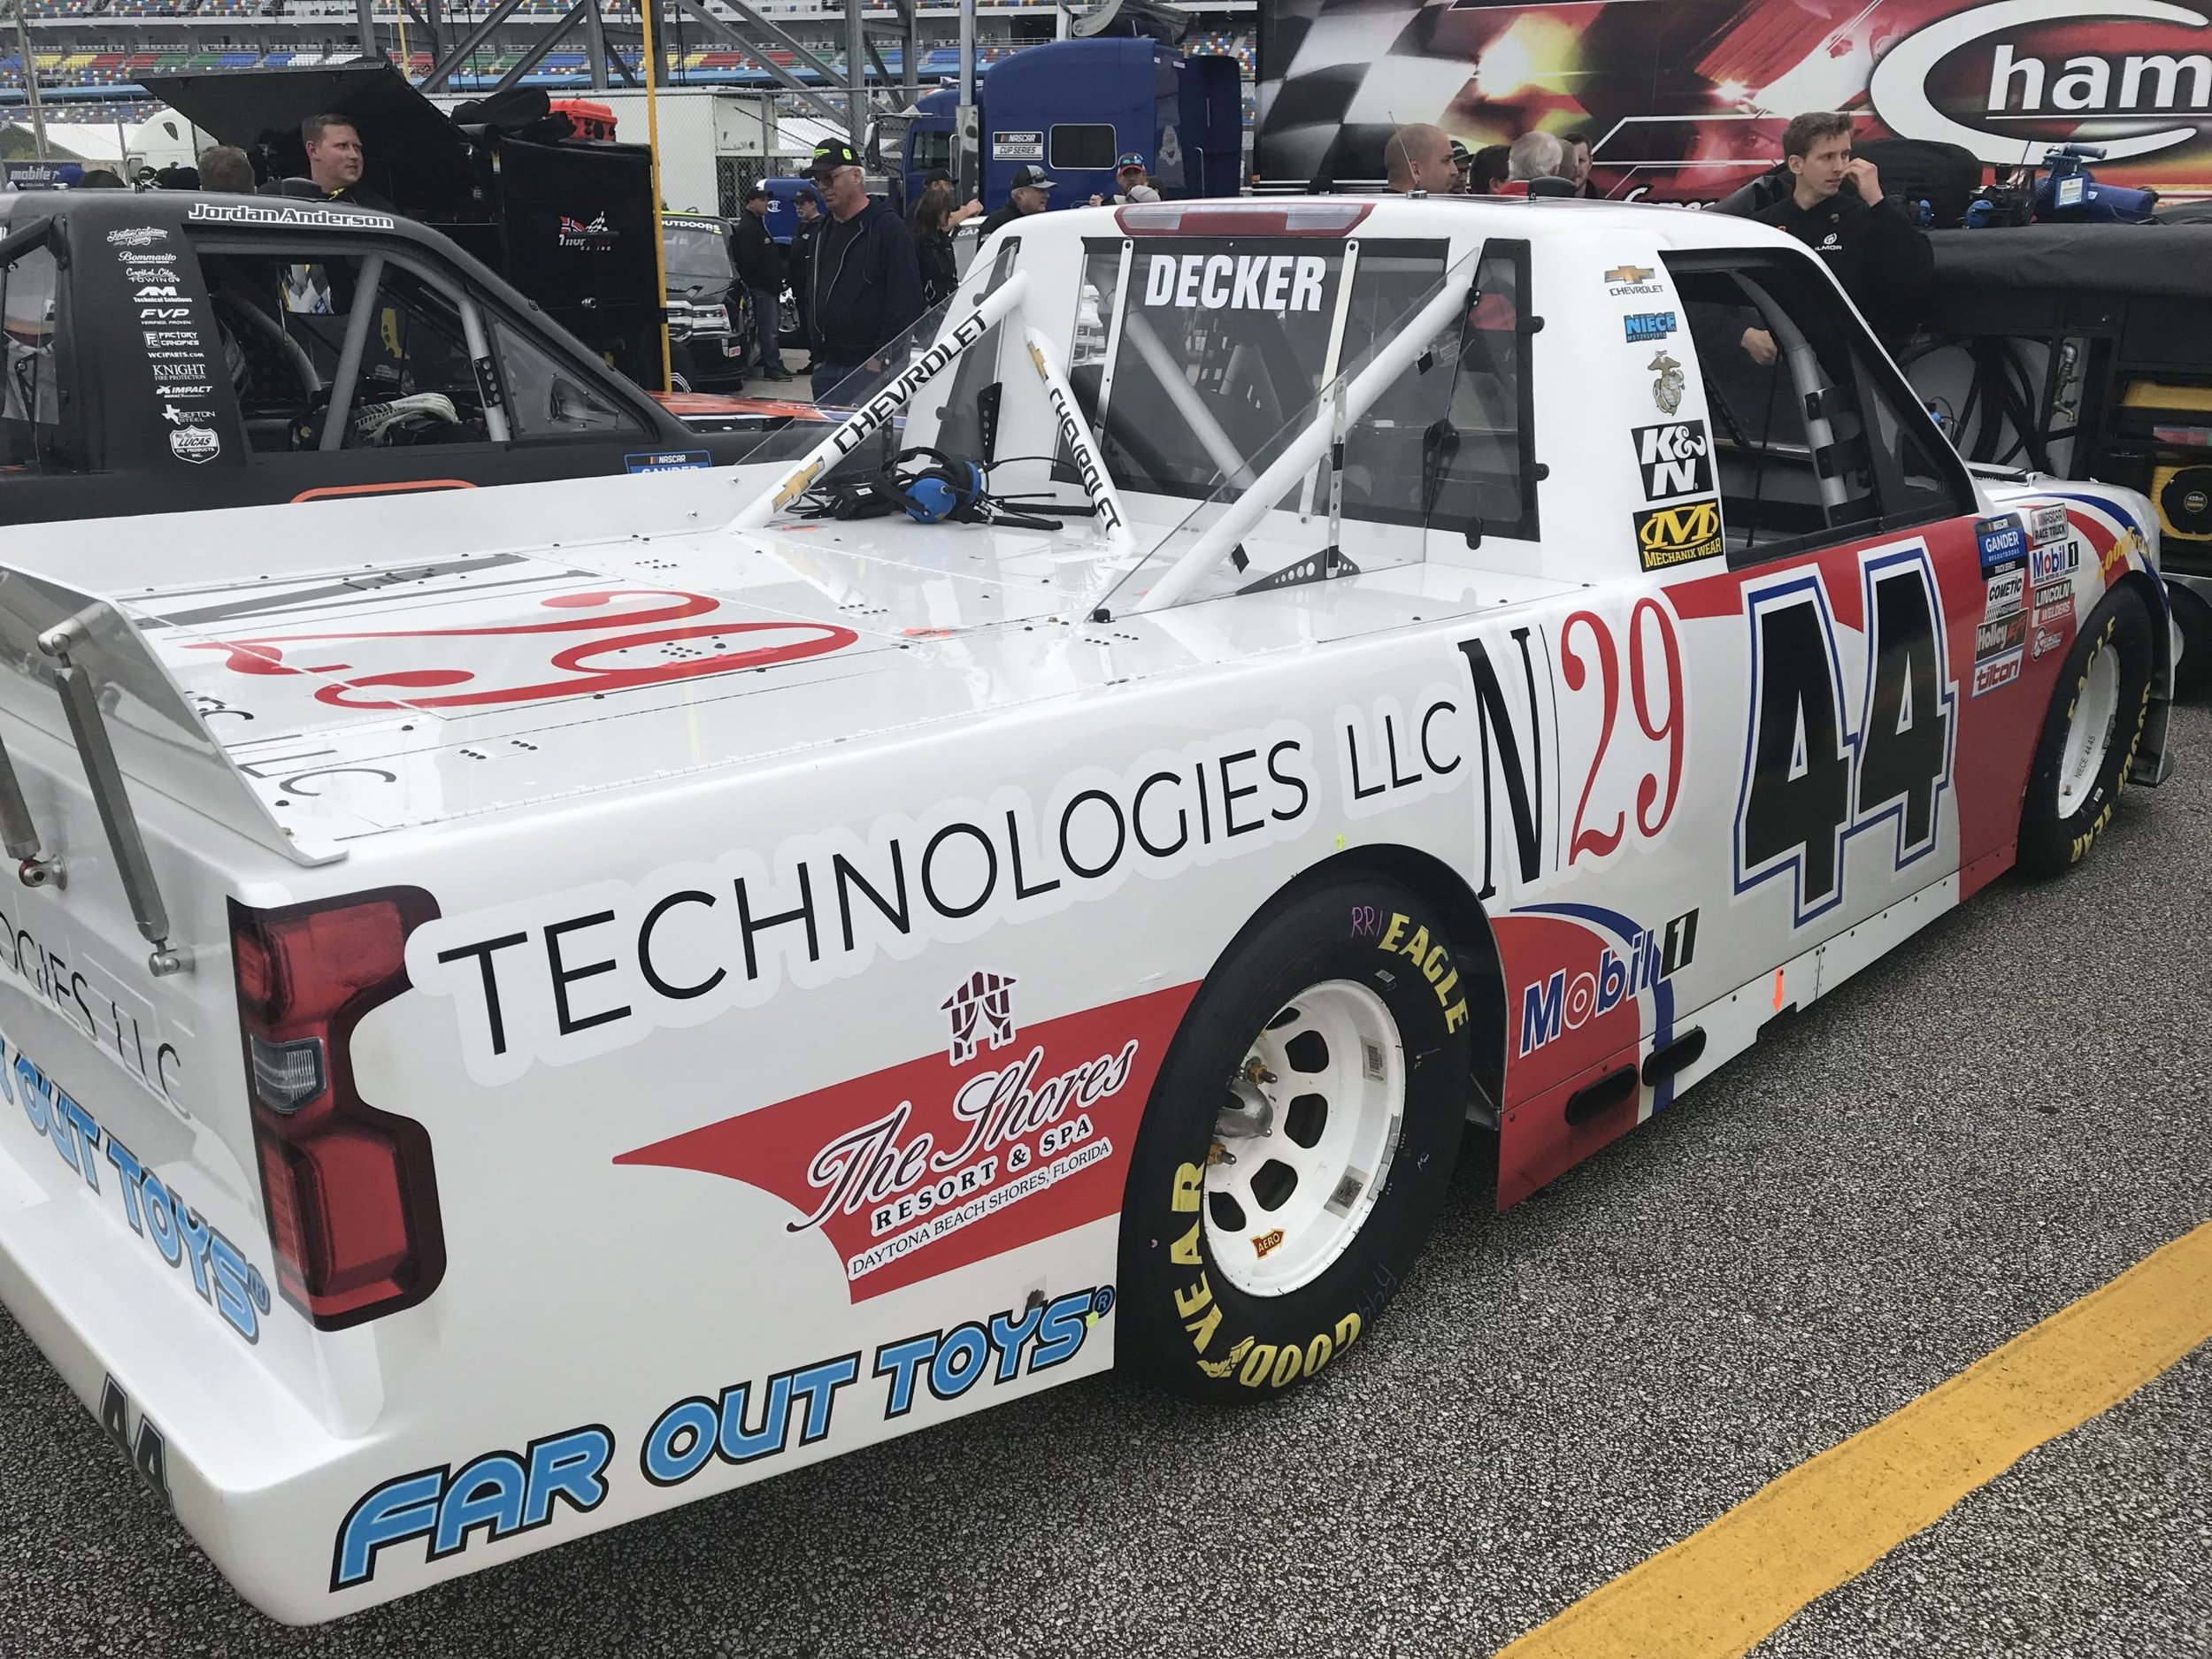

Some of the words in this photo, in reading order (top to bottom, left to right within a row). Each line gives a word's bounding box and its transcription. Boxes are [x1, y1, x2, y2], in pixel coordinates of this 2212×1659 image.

[118, 250, 177, 261] Bommarito
[1145, 254, 1326, 311] DECKER
[1609, 285, 1663, 296] CHEVROLET
[141, 309, 189, 319] FVP
[158, 331, 198, 340] FACTORY
[152, 365, 206, 375] KNIGHT
[833, 310, 987, 455] CHEVROLET
[178, 437, 211, 447] LUCAS
[659, 455, 686, 465] NASCAR
[1985, 531, 2019, 553] GANDER
[2035, 527, 2048, 540] RACE
[2049, 524, 2066, 536] TRUCK
[1644, 548, 1697, 568] MECHANIX
[1698, 537, 1723, 557] WEAR
[2032, 544, 2066, 579] Mobil
[1988, 578, 2023, 603] COMETIC
[2036, 582, 2070, 608] LINCOLN
[2041, 601, 2071, 621] WELDERS
[1978, 623, 2008, 652] Holley
[1977, 659, 2019, 692] tilton
[1732, 547, 1954, 929] 44
[2074, 757, 2088, 779] NIECE
[437, 740, 1309, 1056] TECHNOLOGIES
[1348, 701, 1462, 800] LLC
[1378, 912, 1469, 1034] EAGLE
[1519, 927, 1655, 1060] Mobil
[1657, 906, 1701, 986] 1
[13, 1051, 101, 1197] OUT
[787, 1102, 933, 1233] The
[935, 1040, 1138, 1167] Shores
[874, 1161, 995, 1231] RESORT
[1010, 1148, 1028, 1167] &
[1042, 1118, 1090, 1152] SPA
[852, 1230, 931, 1275] DAYTONA
[933, 1201, 986, 1236] BEACH
[988, 1170, 1050, 1210] SHORES,
[1052, 1141, 1110, 1179] FLORIDA
[1256, 1232, 1280, 1255] AERO
[330, 1423, 616, 1593] FAR
[639, 1350, 863, 1488] OUT
